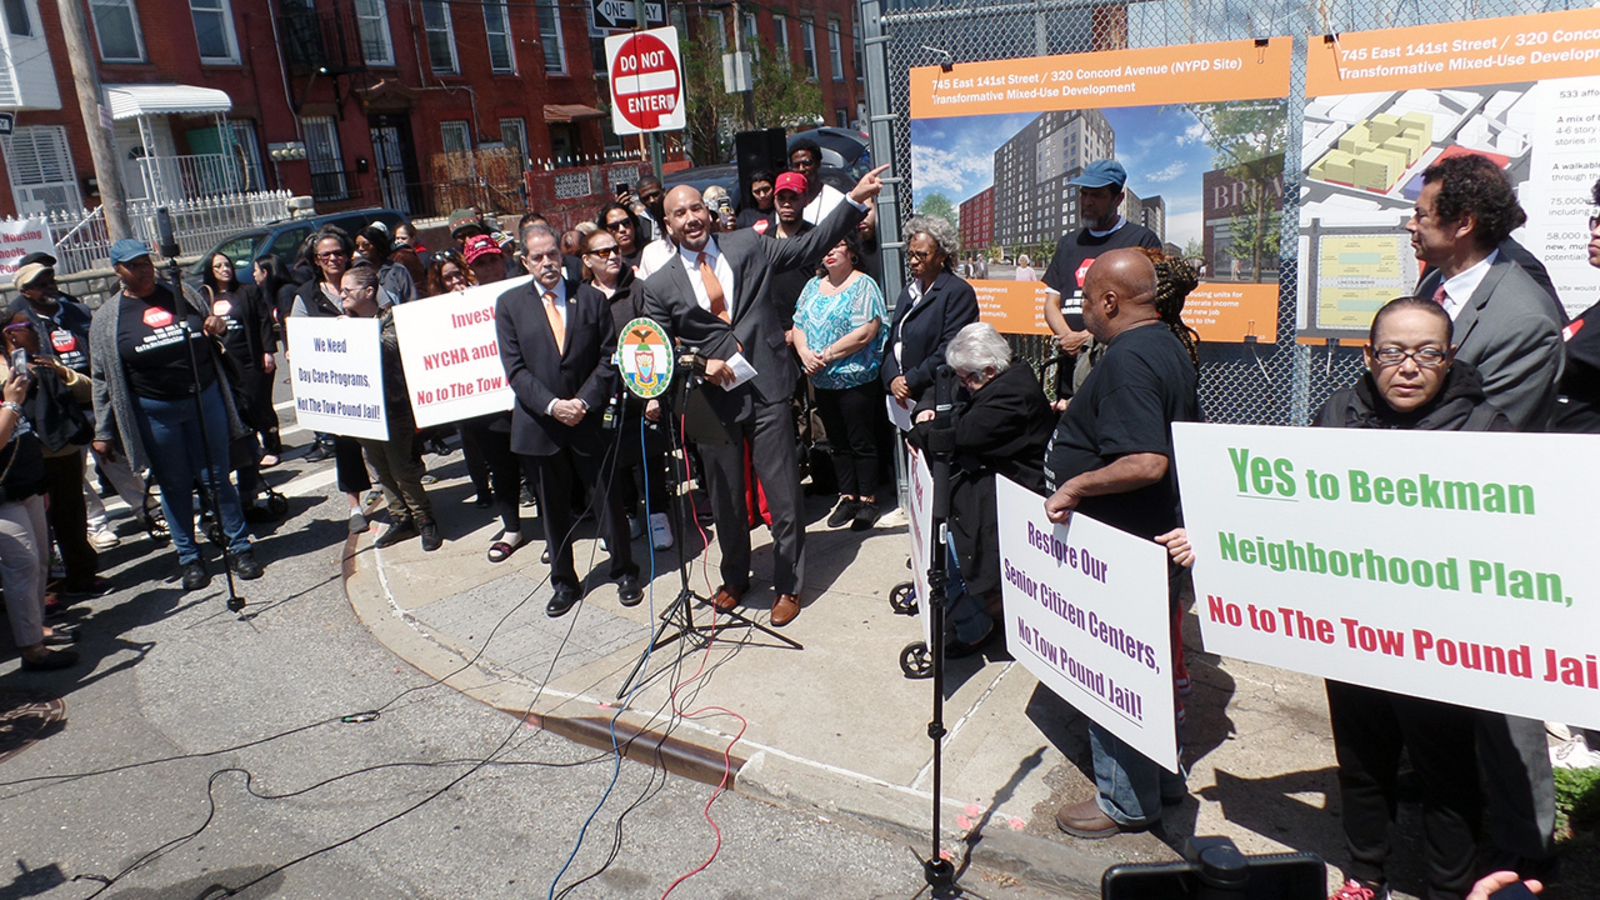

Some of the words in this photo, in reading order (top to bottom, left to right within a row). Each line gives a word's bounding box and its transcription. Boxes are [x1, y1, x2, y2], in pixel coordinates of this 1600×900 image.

[604, 1, 626, 17] ONE
[644, 6, 657, 19] AY
[1341, 50, 1367, 62] 745
[1371, 46, 1401, 59] East
[1405, 42, 1447, 56] 141st
[1452, 37, 1497, 52] Street
[1500, 35, 1510, 50] /
[1514, 30, 1548, 46] 320
[1552, 27, 1600, 44] Conco
[620, 55, 637, 72] DO
[641, 50, 665, 68] NOT
[1339, 60, 1444, 79] Transformative
[1449, 53, 1525, 71] Mixed-Use
[932, 79, 950, 91] 745
[953, 78, 974, 89] East
[977, 76, 1005, 87] 141st
[1007, 72, 1039, 85] Street
[1041, 72, 1048, 84] /
[1051, 70, 1074, 82] 320
[1076, 66, 1122, 80] Concord
[1124, 63, 1168, 77] Avenue
[1171, 59, 1210, 76] (NYPD
[1213, 57, 1242, 71] Site)
[628, 94, 667, 114] ENTER
[932, 89, 1004, 105] Transformative
[1007, 86, 1059, 100] Mixed-Use
[1062, 82, 1136, 97] Development
[1560, 90, 1578, 98] 533
[1581, 89, 1600, 97] affo
[1574, 126, 1597, 134] story
[1555, 138, 1586, 146] stories
[1552, 173, 1586, 182] through
[1549, 208, 1590, 217] including
[2, 230, 42, 243] Housing
[451, 306, 496, 329] Invest
[313, 337, 327, 352] We
[327, 338, 347, 353] Need
[423, 347, 470, 371] NYCHA
[472, 340, 498, 361] and
[298, 368, 311, 384] Day
[312, 369, 329, 384] Care
[330, 371, 370, 388] Programs,
[417, 390, 433, 406] No
[436, 387, 449, 402] to
[449, 381, 474, 398] The
[476, 375, 502, 395] Tow
[297, 397, 309, 411] Not
[309, 398, 322, 413] The
[322, 400, 336, 415] Tow
[337, 401, 362, 418] Pound
[363, 403, 381, 420] Jail!
[1227, 447, 1297, 497] Yes
[1305, 469, 1340, 501] to
[1348, 469, 1536, 515] Beekman
[1027, 520, 1078, 570] Restore
[1081, 547, 1108, 584] Our
[1218, 531, 1460, 591] Neighborhood
[1468, 559, 1573, 608] Plan,
[1004, 557, 1038, 601] Senior
[1040, 582, 1086, 632] Citizen
[1088, 611, 1161, 674] Centers,
[1207, 594, 1243, 627] No
[1247, 603, 1277, 634] to
[1278, 606, 1335, 645] The
[1340, 617, 1405, 657] Tow
[1412, 629, 1533, 679] Pound
[1543, 648, 1600, 689] Jai
[1017, 616, 1032, 644] No
[1032, 627, 1058, 666] Tow
[1059, 646, 1104, 698] Pound
[1108, 678, 1143, 721] Jail!
